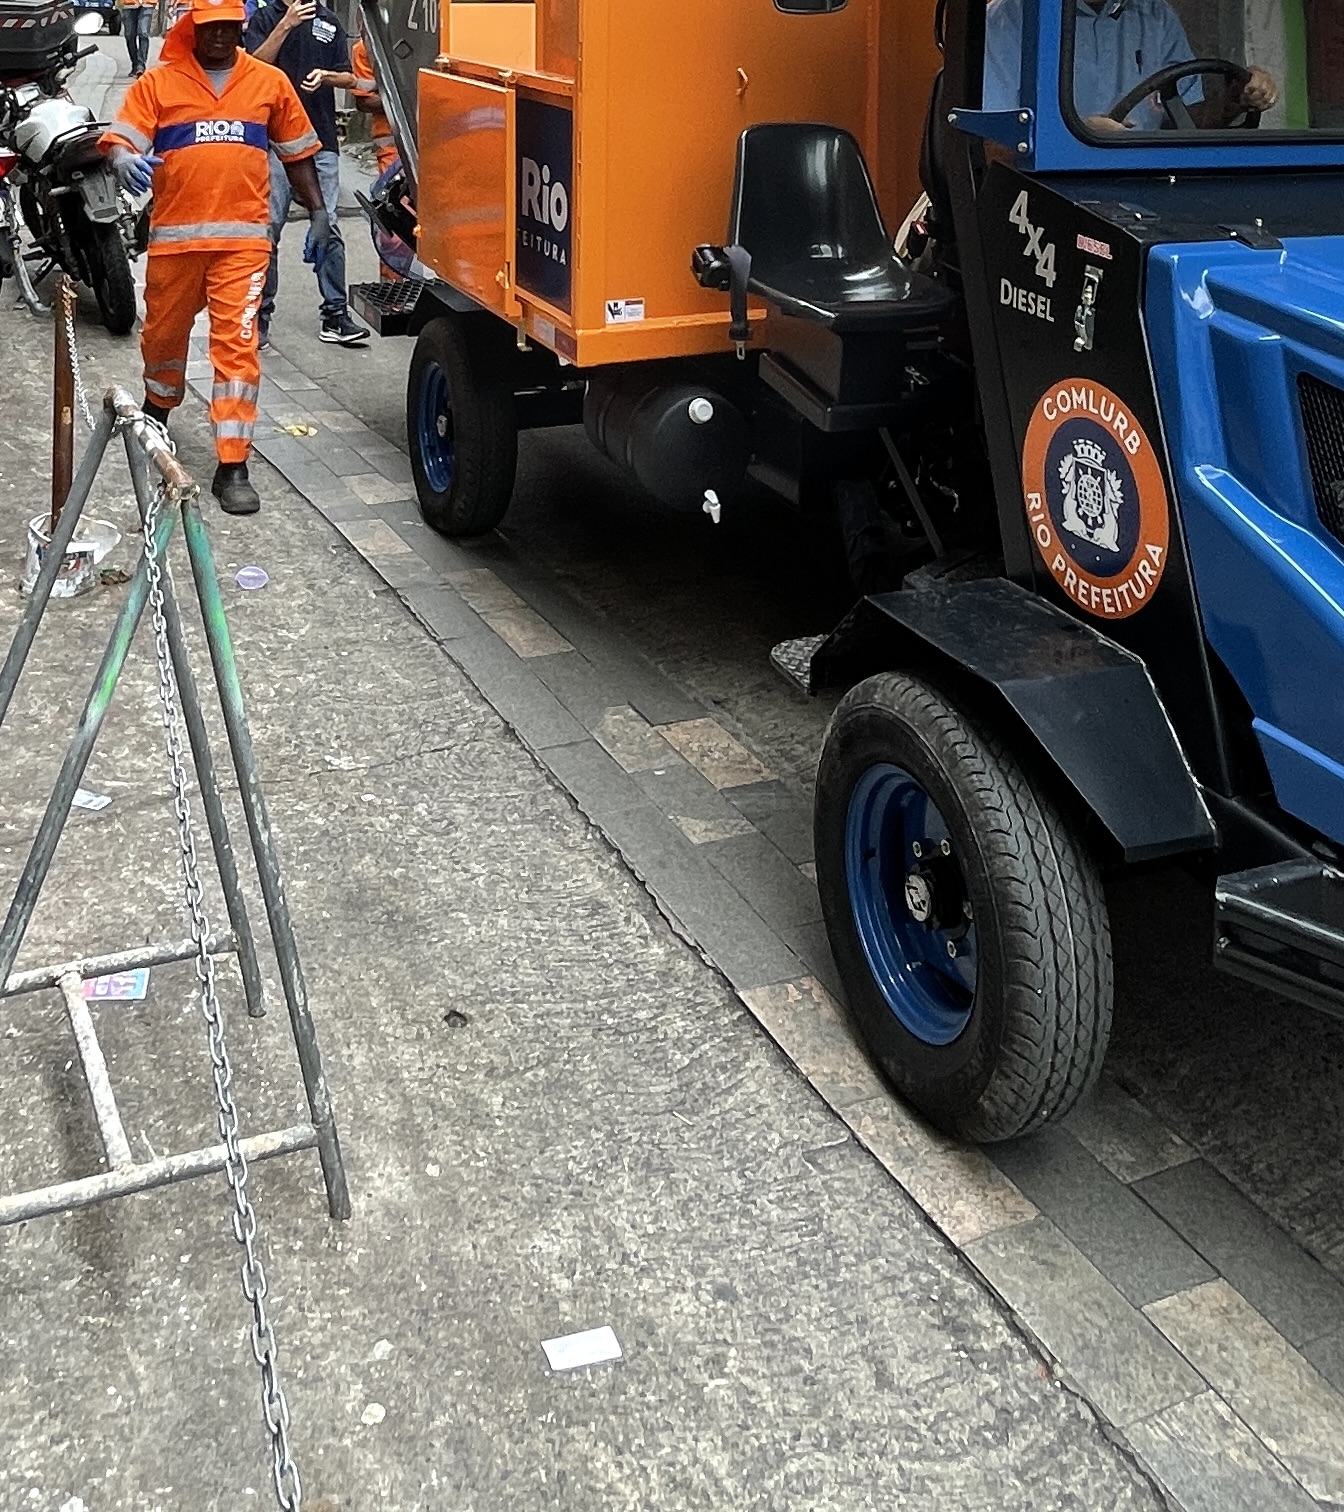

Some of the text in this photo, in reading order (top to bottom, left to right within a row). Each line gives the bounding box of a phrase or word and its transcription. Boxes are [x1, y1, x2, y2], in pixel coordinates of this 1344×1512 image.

[196, 120, 230, 136] RIO
[522, 157, 568, 232] Rio
[1000, 278, 1055, 323] DIESEL
[1043, 386, 1142, 455] COMLURB
[1026, 491, 1164, 614] RIO PREFEITURA
